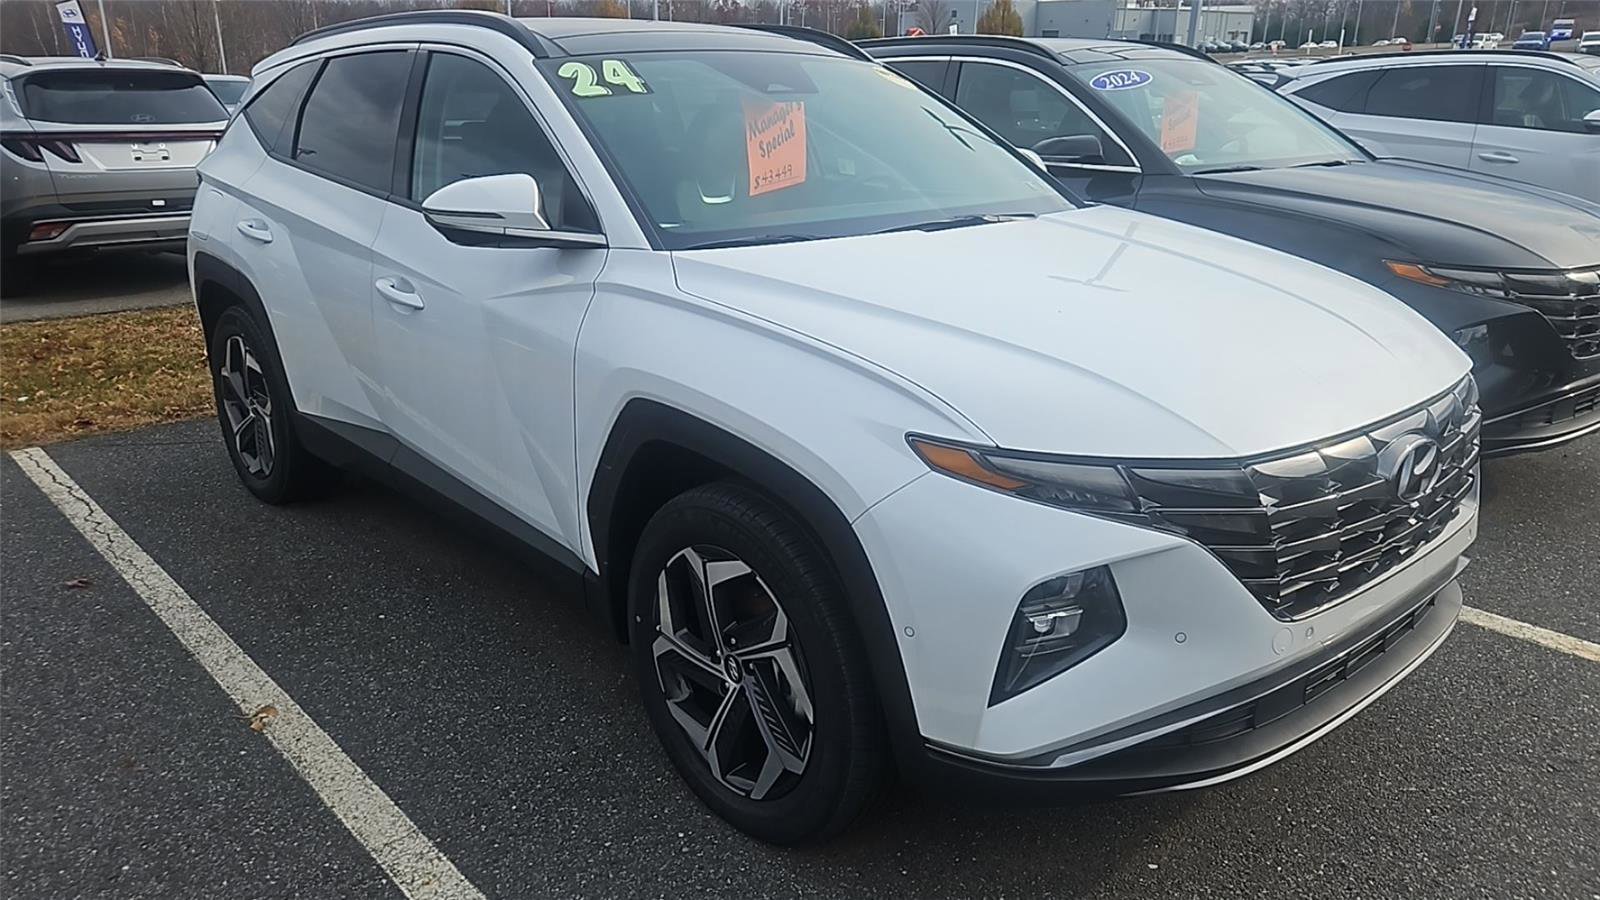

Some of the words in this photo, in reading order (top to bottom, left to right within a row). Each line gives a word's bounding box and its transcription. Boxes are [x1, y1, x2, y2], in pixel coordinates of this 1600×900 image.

[558, 60, 647, 96] 24
[1100, 71, 1141, 89] 2024
[758, 119, 796, 158] Special
